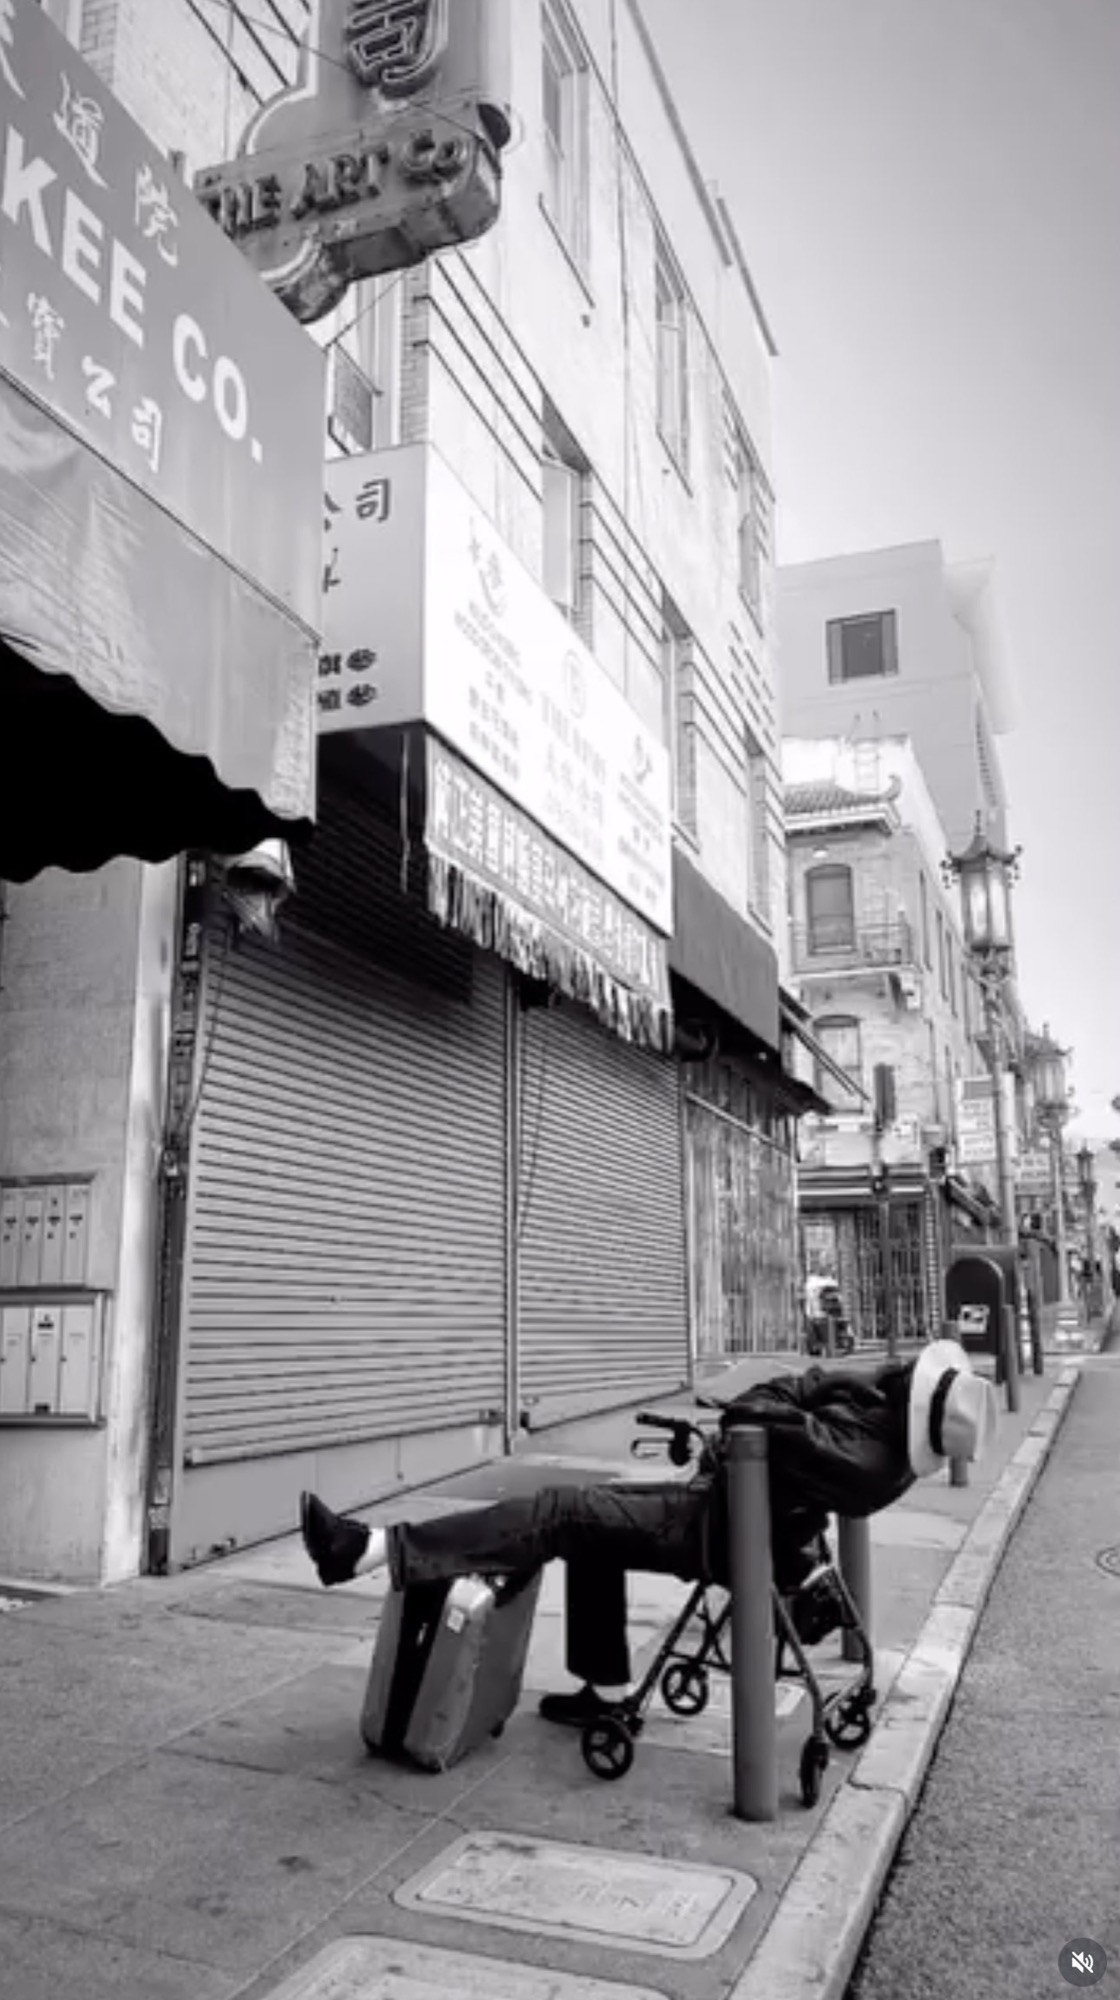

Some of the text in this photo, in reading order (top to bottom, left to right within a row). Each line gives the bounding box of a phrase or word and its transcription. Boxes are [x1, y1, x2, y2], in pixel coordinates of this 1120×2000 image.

[292, 147, 390, 220] ART
[2, 126, 262, 463] KEE CO.
